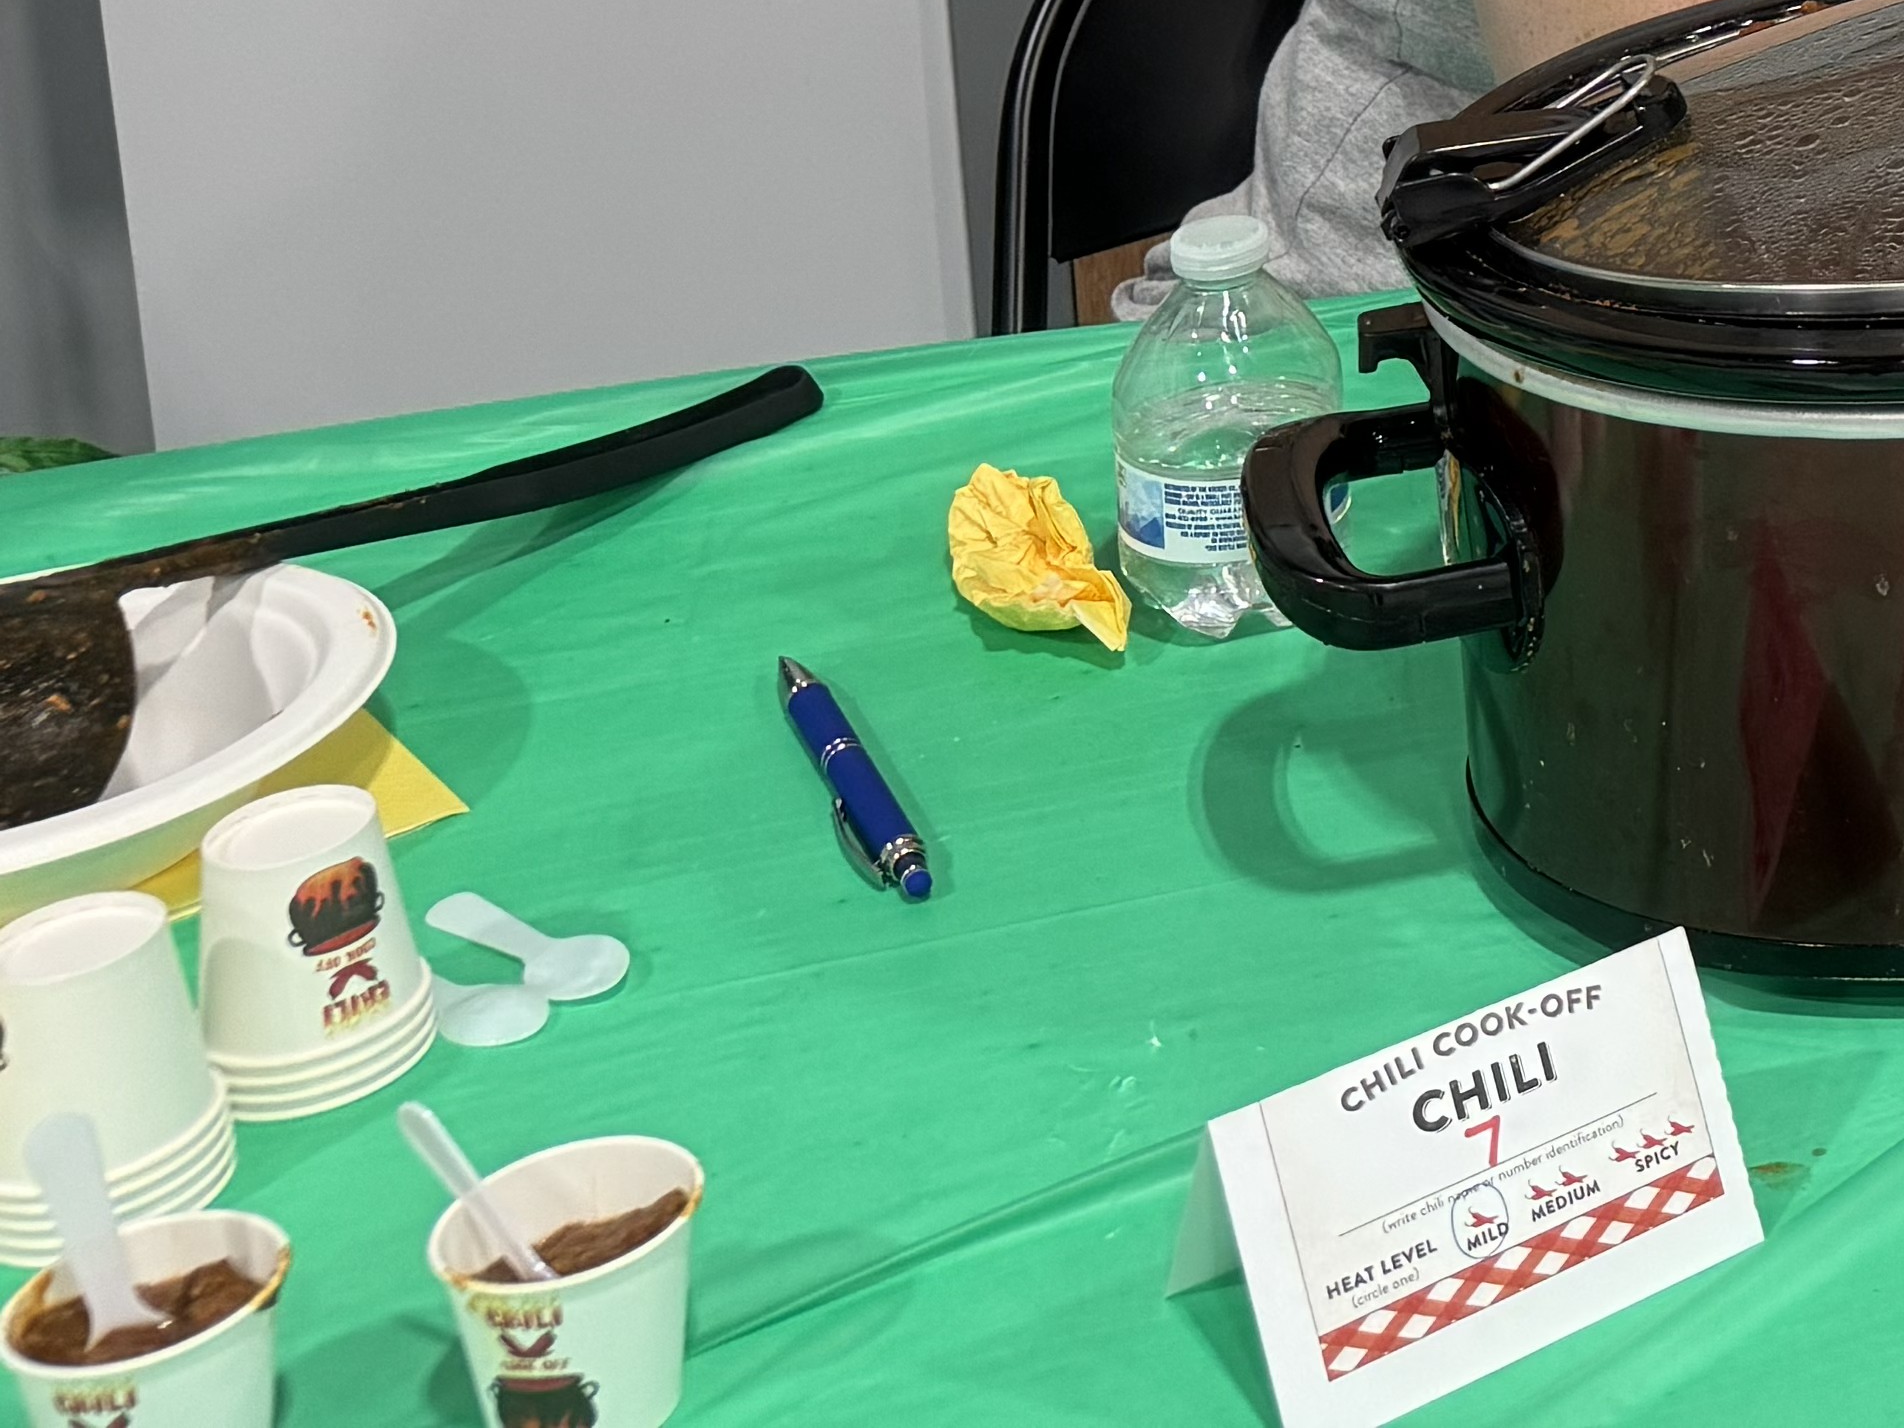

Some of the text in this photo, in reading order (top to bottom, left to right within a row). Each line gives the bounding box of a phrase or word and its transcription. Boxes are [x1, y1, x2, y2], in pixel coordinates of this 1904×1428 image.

[1339, 984, 1603, 1114] CHILI COOK-OFF
[1411, 1040, 1559, 1134] CHILI
[1464, 1114, 1501, 1167] 7
[1634, 1140, 1680, 1173] SPICY
[1381, 1211, 1417, 1234] (write
[1420, 1198, 1444, 1217] chili
[1498, 1153, 1543, 1182] number
[1545, 1114, 1625, 1159] identification)
[1531, 1179, 1601, 1223] MEDIUM
[1466, 1222, 1510, 1252] MILD
[1326, 1239, 1438, 1300] HEAT LEVEL
[1351, 1267, 1420, 1308] (circle one)
